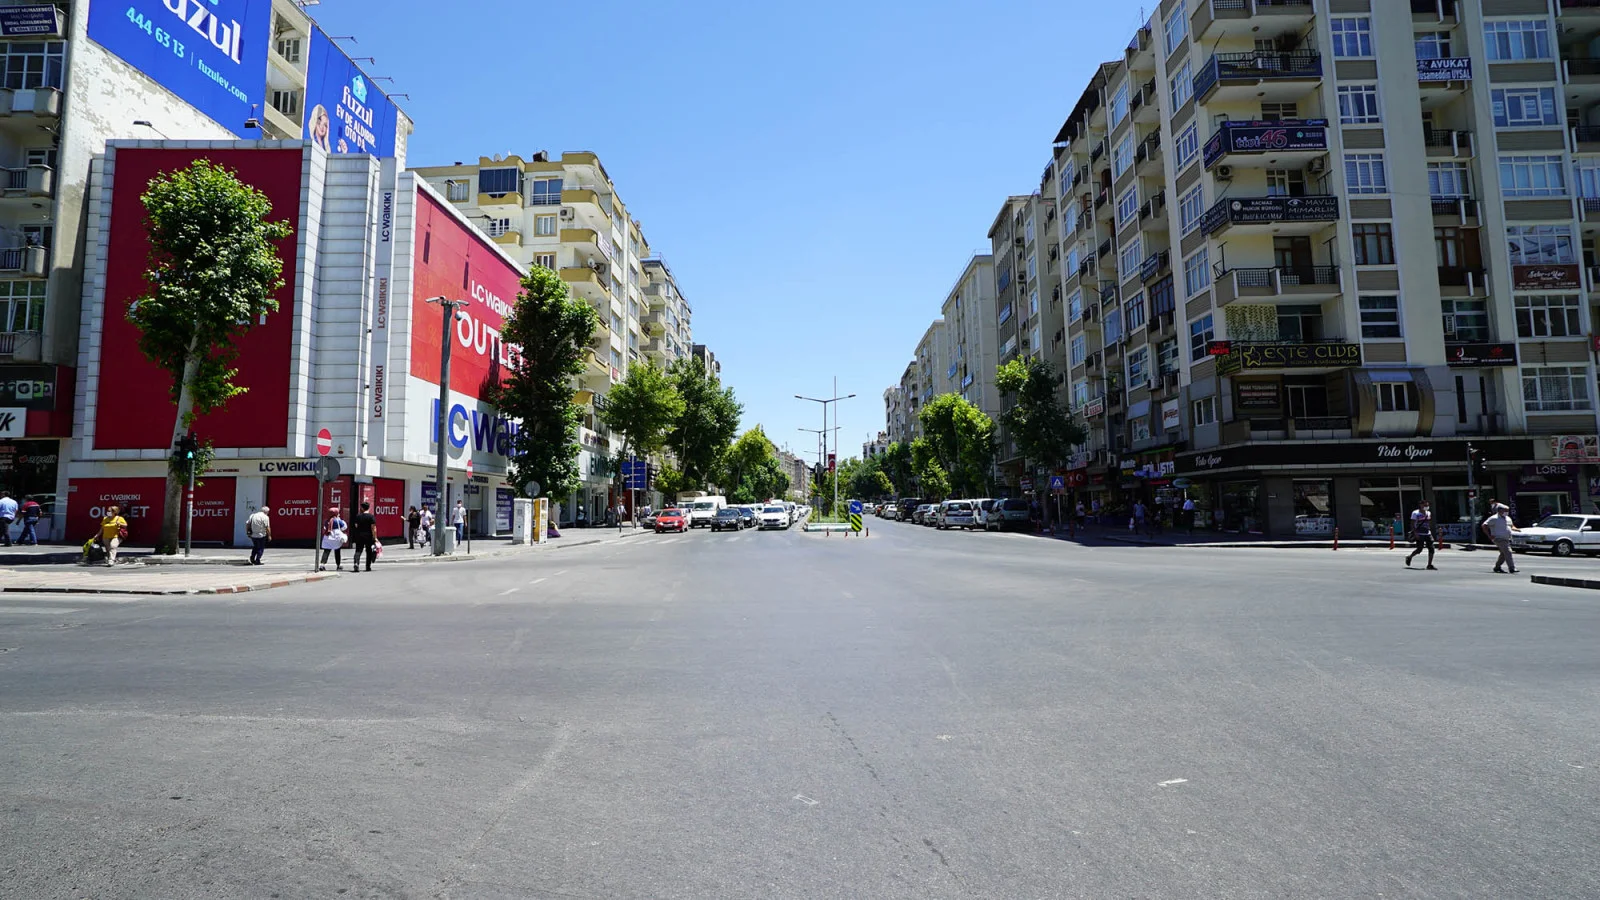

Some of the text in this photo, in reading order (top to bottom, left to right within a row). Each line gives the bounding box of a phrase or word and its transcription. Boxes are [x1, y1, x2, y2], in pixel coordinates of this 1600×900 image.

[162, 0, 241, 65] uzul
[126, 6, 248, 104] 444 63 13 fuzulev.com
[1430, 59, 1468, 68] AVUKAT
[342, 85, 374, 128] fuzul
[336, 104, 344, 120] EV
[344, 110, 353, 128] DE
[344, 125, 356, 142] OTO
[1235, 129, 1288, 148] tivi46
[382, 228, 389, 242] LC
[471, 280, 484, 303] LC
[378, 314, 386, 328] LC
[1264, 346, 1358, 364] ESTE CLUB
[374, 404, 382, 418] LC
[1378, 445, 1432, 460] Polo Spor
[260, 462, 275, 472] LC
[192, 508, 230, 517] OUTLET
[278, 507, 317, 516] OUTLET
[376, 506, 399, 515] OUTLET
